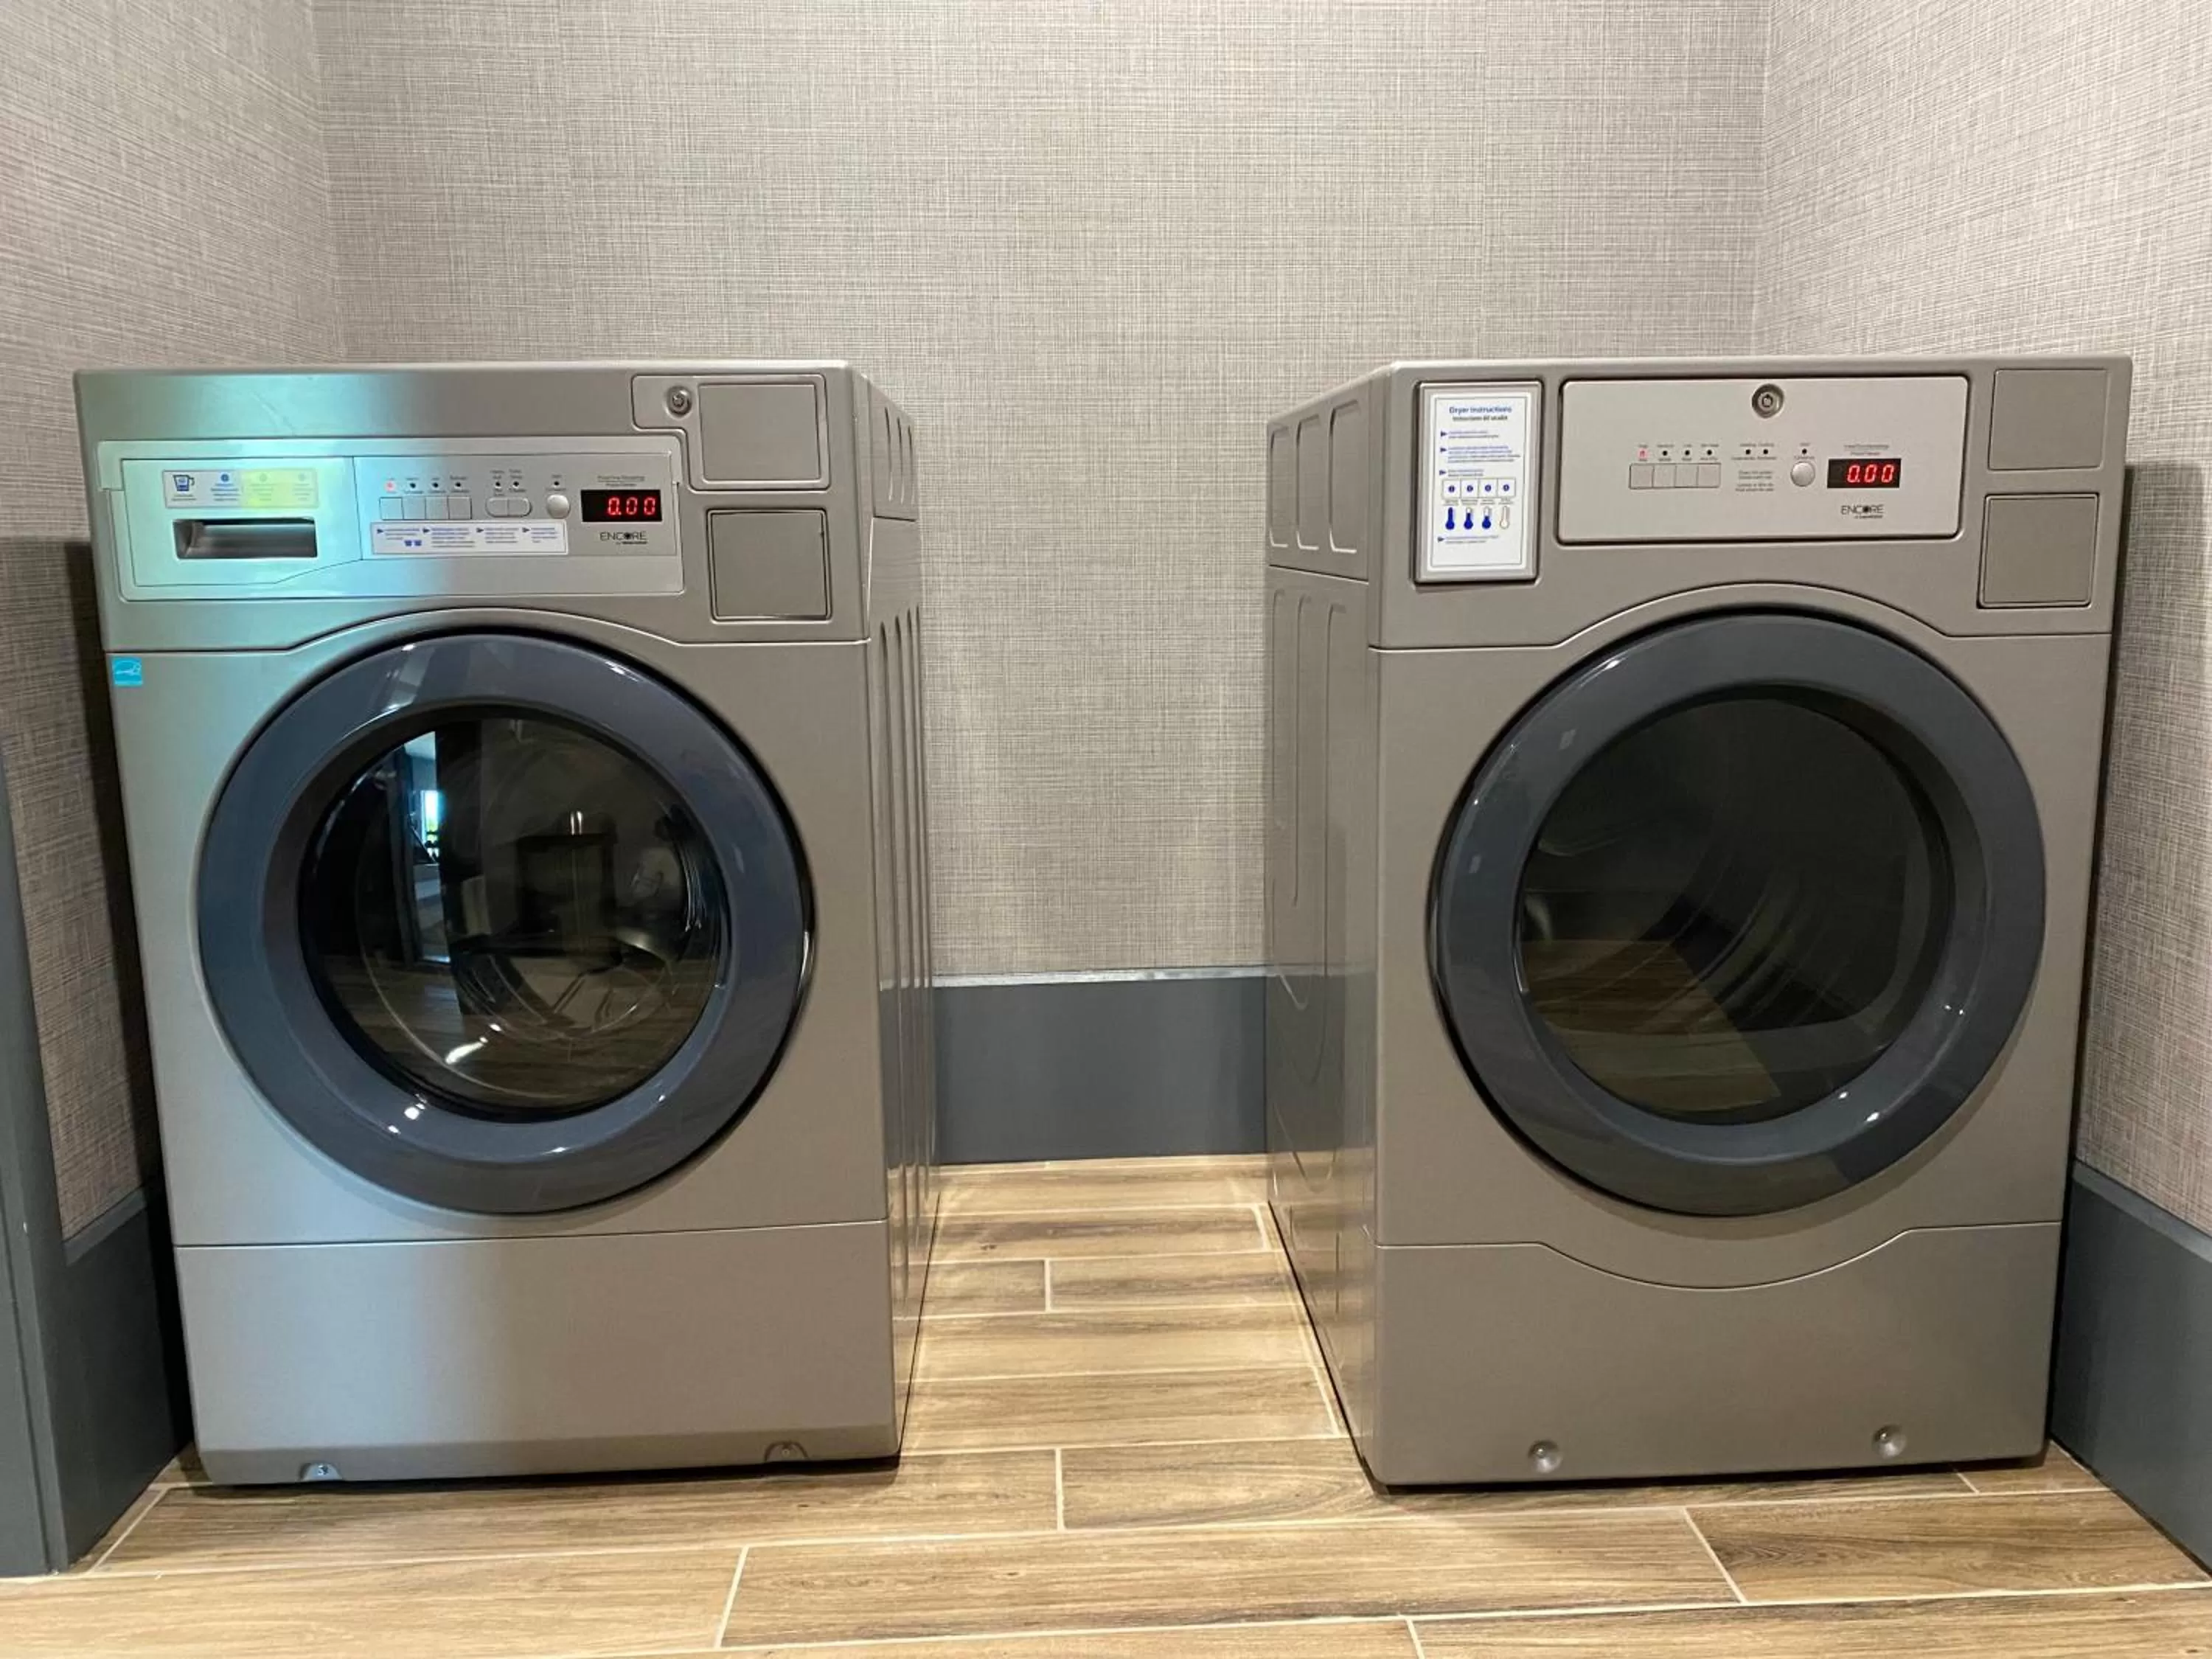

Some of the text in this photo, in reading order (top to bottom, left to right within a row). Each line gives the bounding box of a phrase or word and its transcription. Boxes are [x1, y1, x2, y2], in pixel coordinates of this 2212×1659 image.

[1847, 465, 1894, 483] 0.00
[608, 497, 656, 515] 0.00
[1840, 504, 1884, 515] ENCORE
[599, 531, 647, 541] ENCORE
